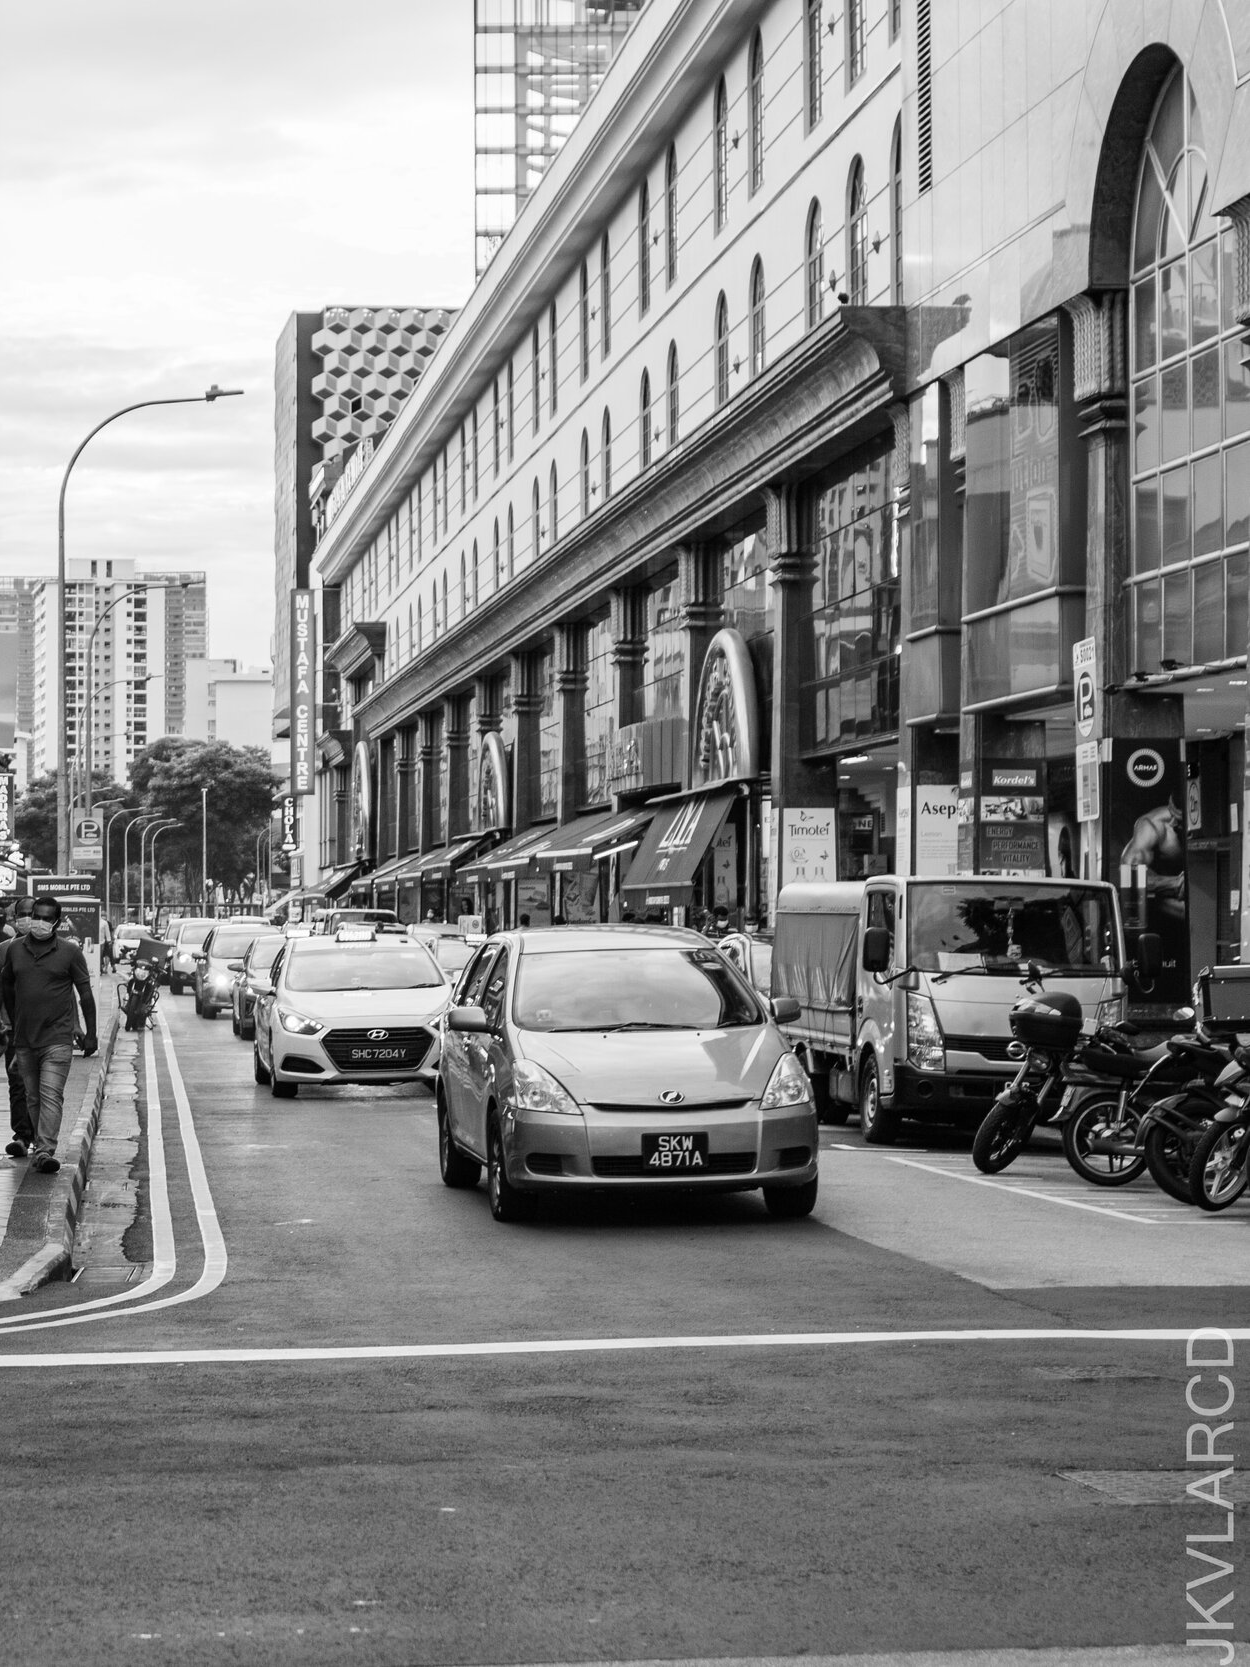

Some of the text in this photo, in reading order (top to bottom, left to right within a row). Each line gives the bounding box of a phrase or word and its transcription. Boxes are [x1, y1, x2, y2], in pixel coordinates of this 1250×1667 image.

[295, 594, 309, 694] MUSTAFA
[295, 704, 309, 790] CENTRE
[993, 776, 1035, 785] Kordel's
[921, 802, 958, 819] Asep
[284, 797, 294, 843] CHOLA
[788, 822, 830, 836] Timotei
[987, 826, 1013, 836] ENERGY
[993, 840, 1039, 850] PERFORMANCE
[1002, 853, 1030, 863] VITALITY
[658, 1135, 693, 1151] SKW
[649, 1151, 703, 1166] 4871A
